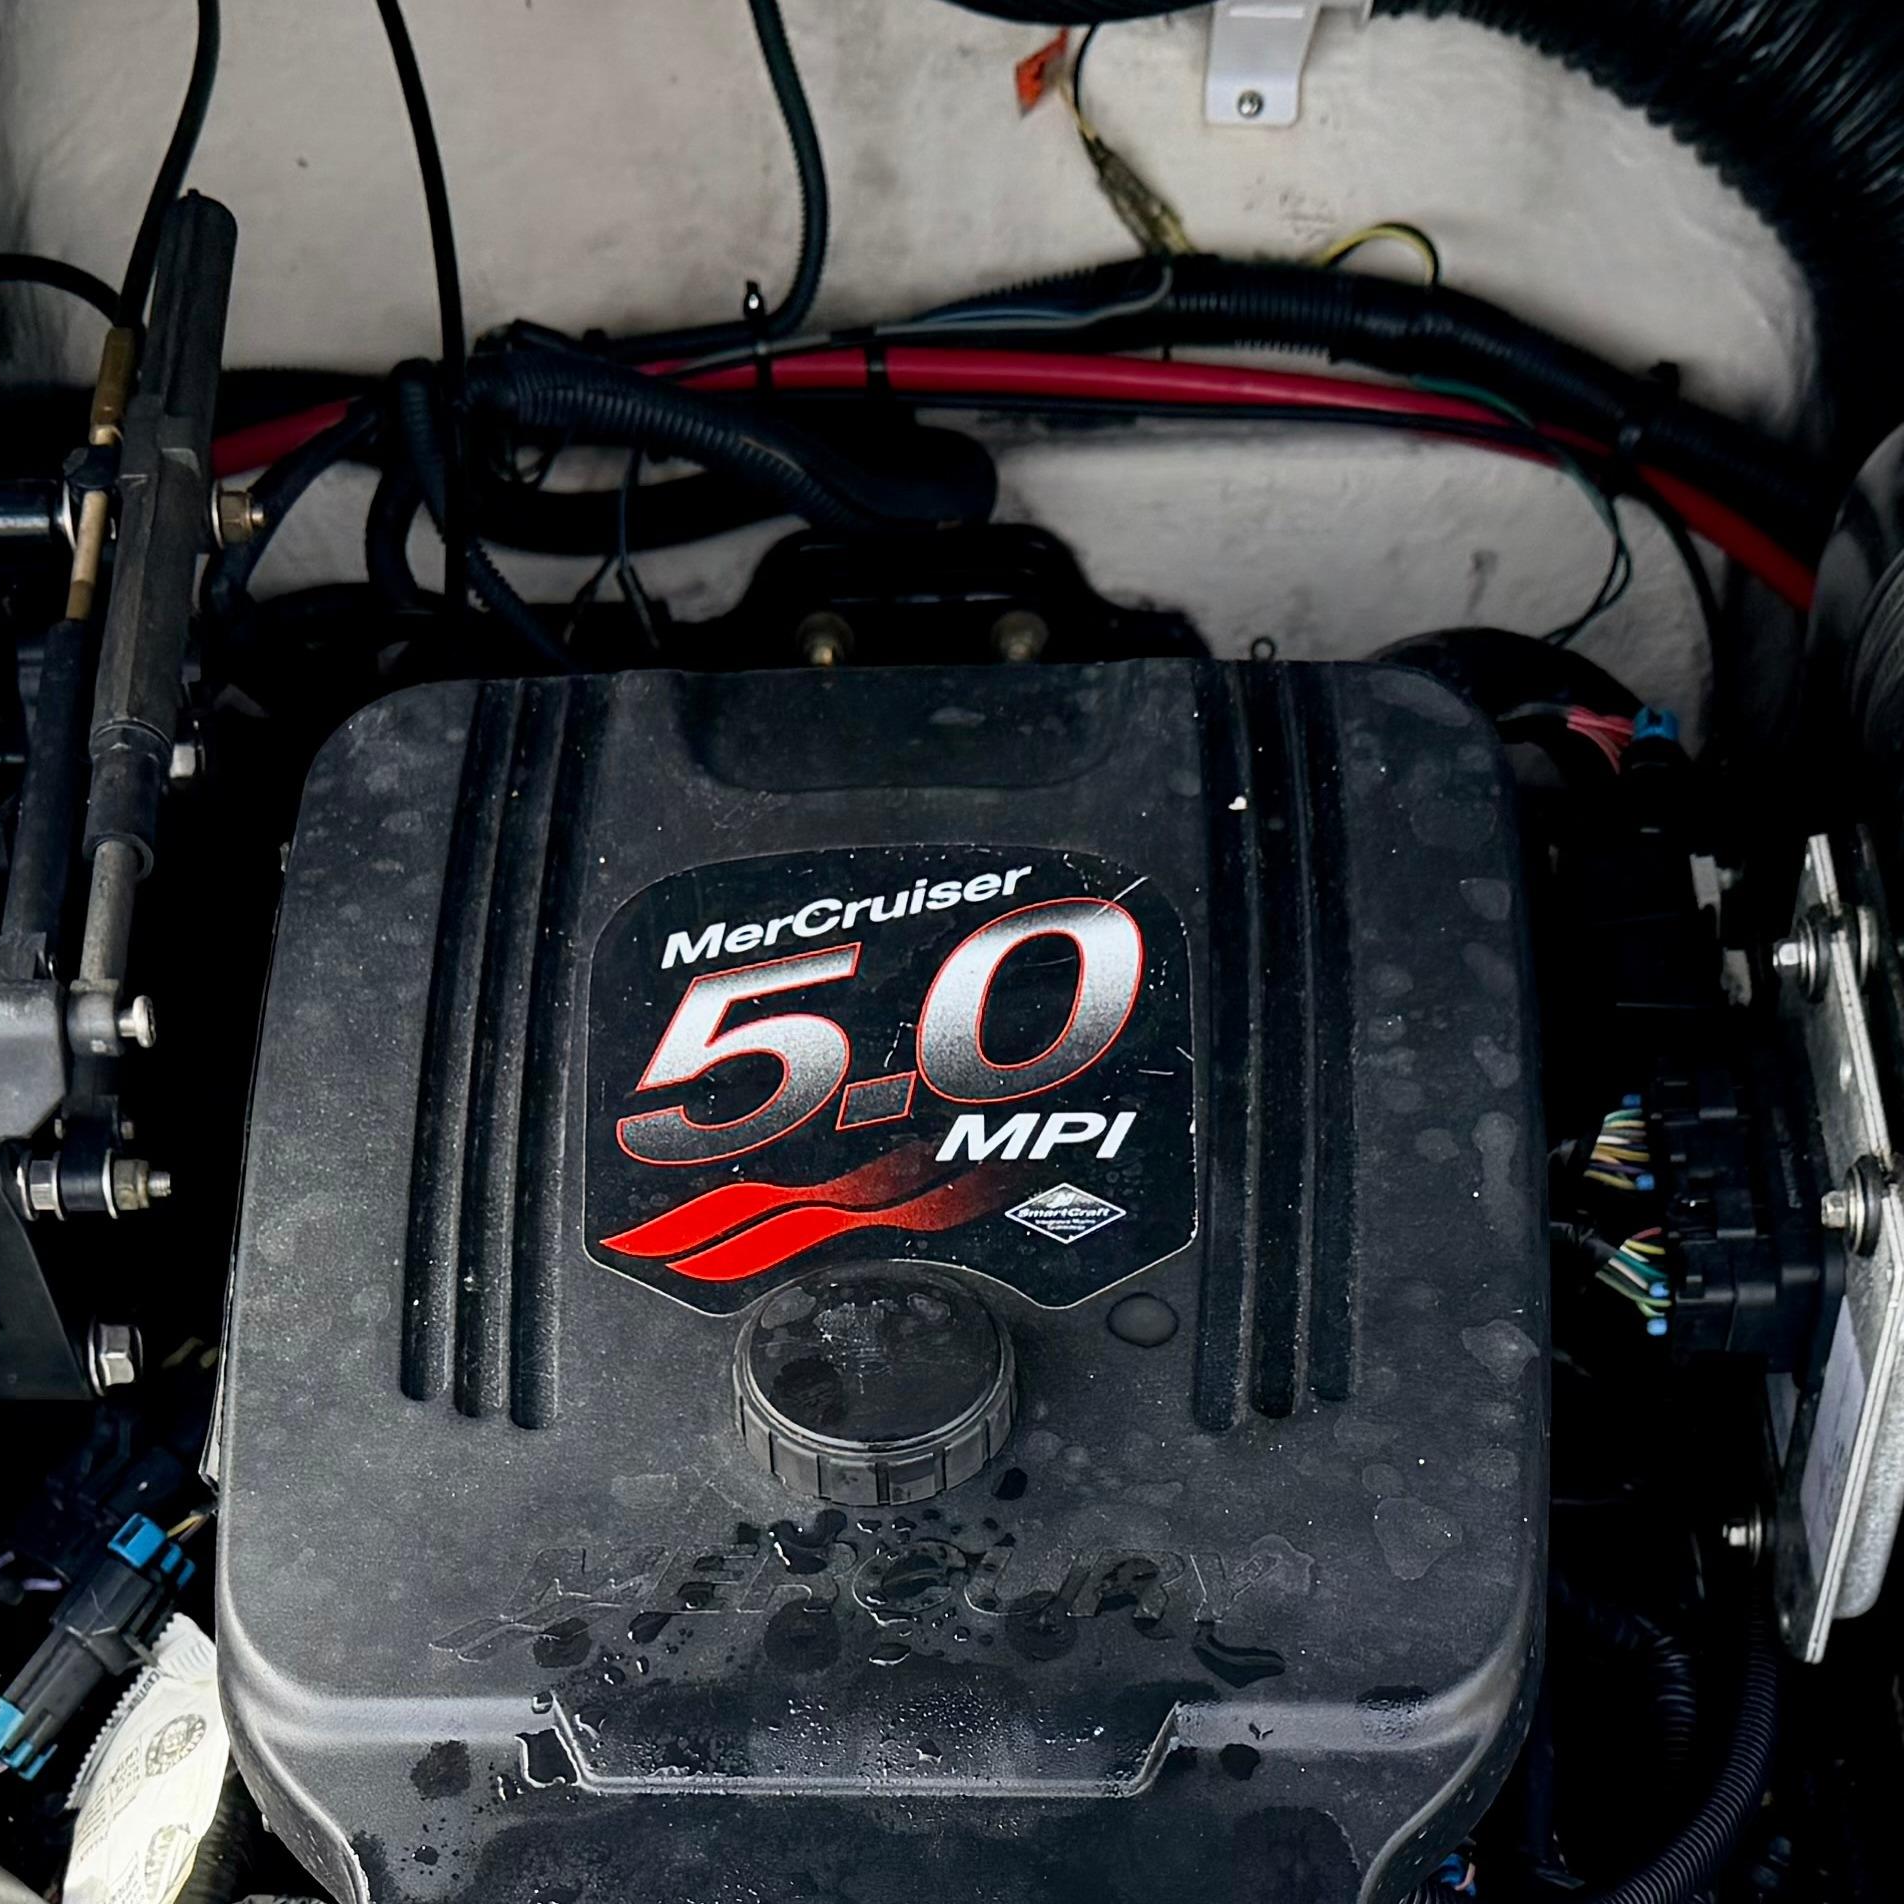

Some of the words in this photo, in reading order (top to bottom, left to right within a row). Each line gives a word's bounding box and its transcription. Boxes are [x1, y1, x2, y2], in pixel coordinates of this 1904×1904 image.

[660, 866, 1032, 969] MerCruiser
[616, 897, 1145, 1164] 5.0
[935, 1112, 1137, 1161] MPI
[1018, 1207, 1110, 1218] SmartCraft
